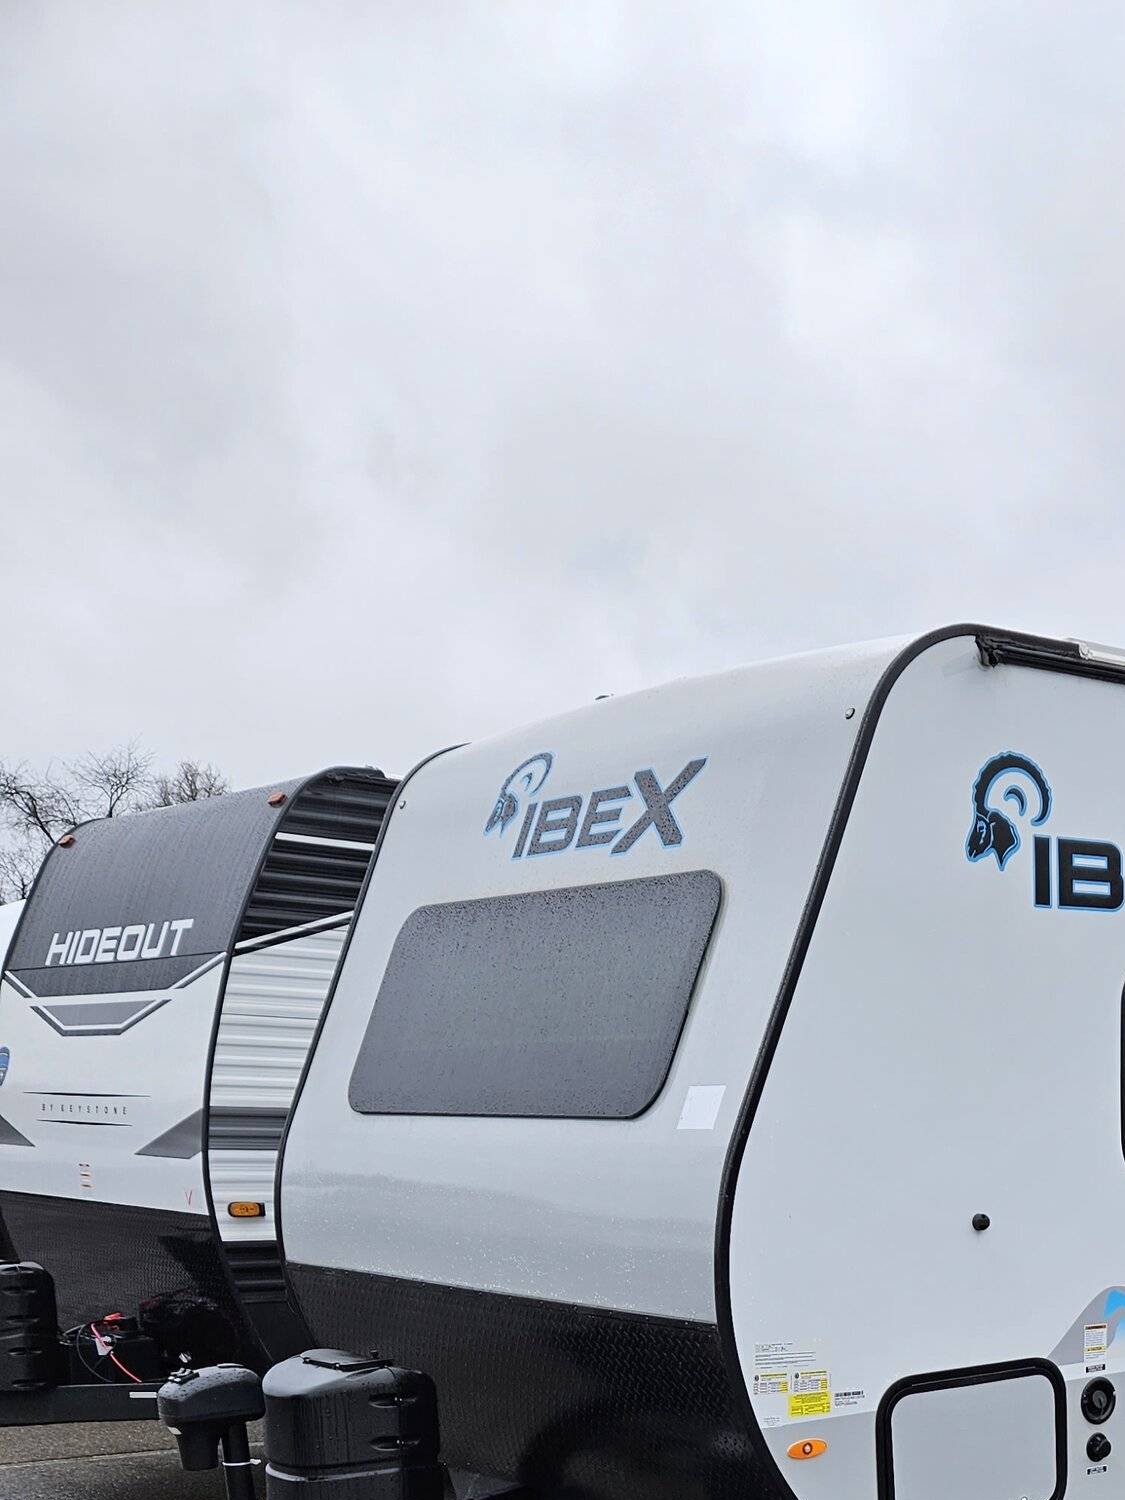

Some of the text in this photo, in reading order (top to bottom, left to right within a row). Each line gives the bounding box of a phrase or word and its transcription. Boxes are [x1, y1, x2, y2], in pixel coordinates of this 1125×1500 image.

[511, 756, 709, 860] IBEX
[44, 918, 194, 966] HIDEOUT
[60, 1104, 127, 1115] KEYSTONE
